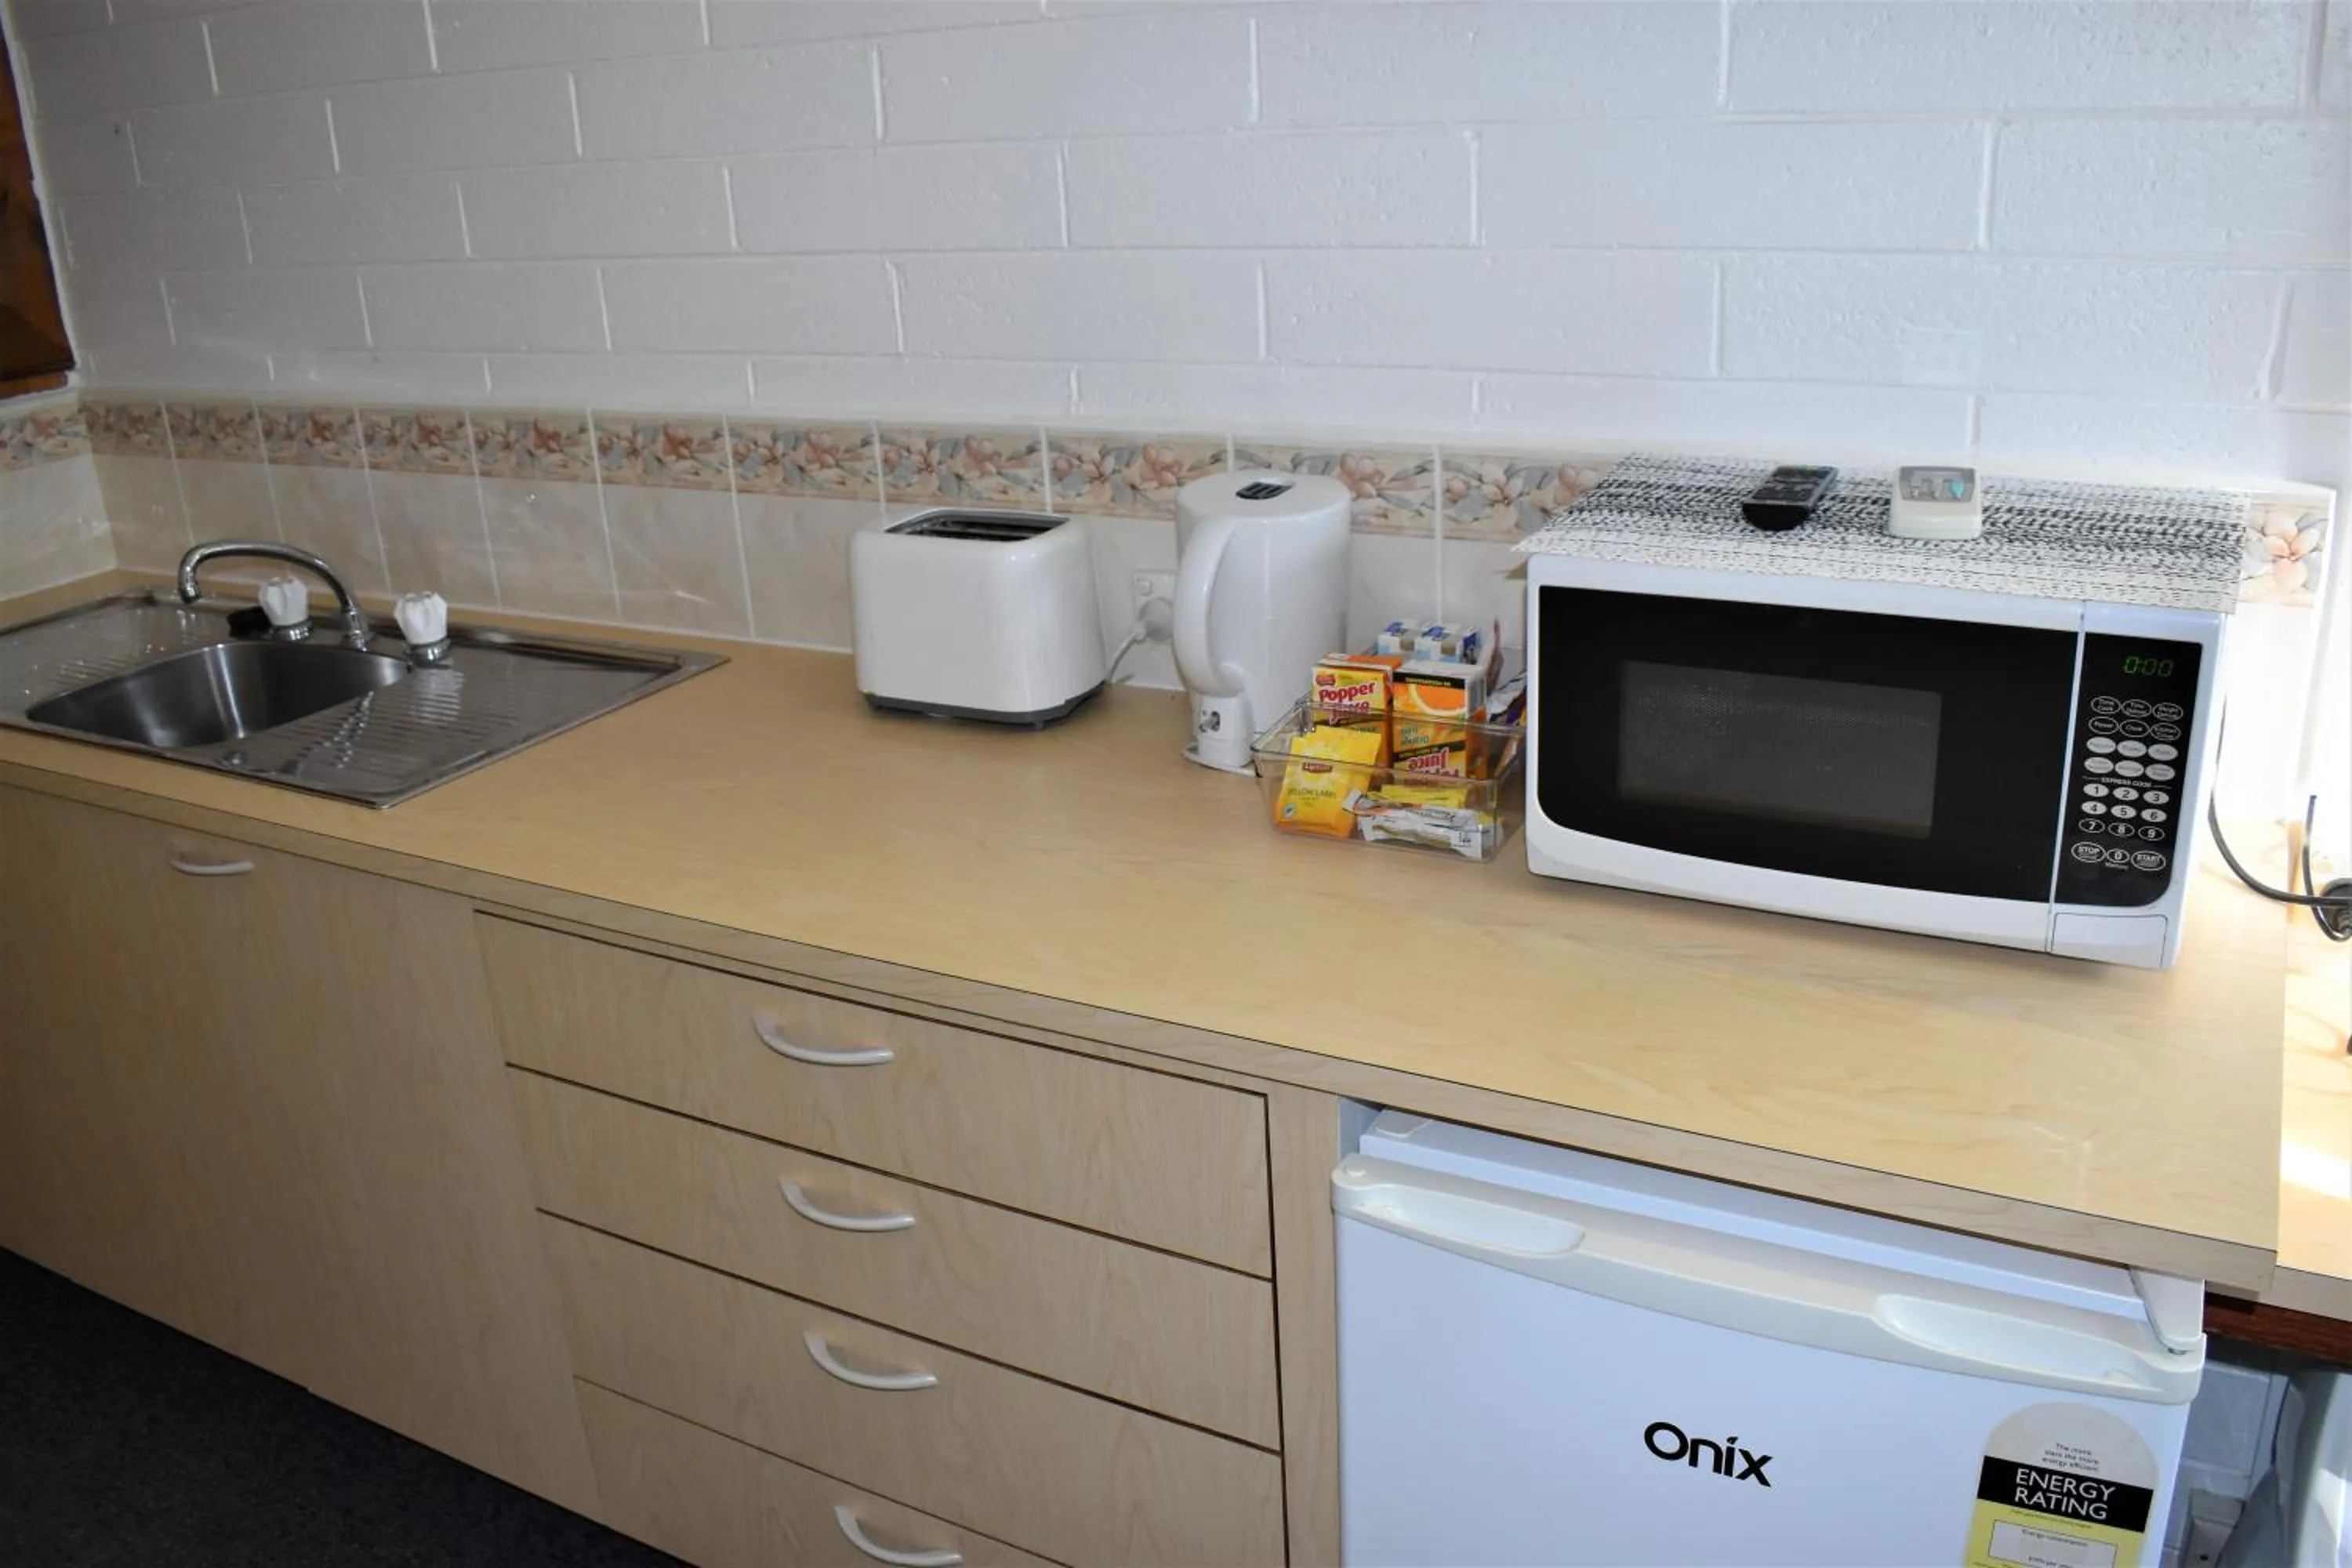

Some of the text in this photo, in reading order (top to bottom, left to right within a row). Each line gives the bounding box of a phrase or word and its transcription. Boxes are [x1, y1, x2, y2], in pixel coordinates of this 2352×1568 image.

[2124, 656, 2173, 677] 0:00
[1319, 682, 1376, 703] Popper
[2093, 786, 2099, 794] 1
[2122, 789, 2130, 799] 2
[2153, 793, 2160, 802] 3
[2090, 804, 2098, 812] 4
[2120, 807, 2127, 816] 5
[2151, 811, 2158, 821] 6
[2089, 821, 2096, 830] 7
[2118, 824, 2125, 834] 8
[2148, 829, 2156, 838] 9
[2114, 851, 2122, 860] 0
[2056, 1443, 2069, 1451] The
[1644, 1421, 1774, 1487] Onix
[2042, 1457, 2067, 1468] energy
[2016, 1468, 2116, 1501] ENERGY
[2014, 1488, 2108, 1519] RATING
